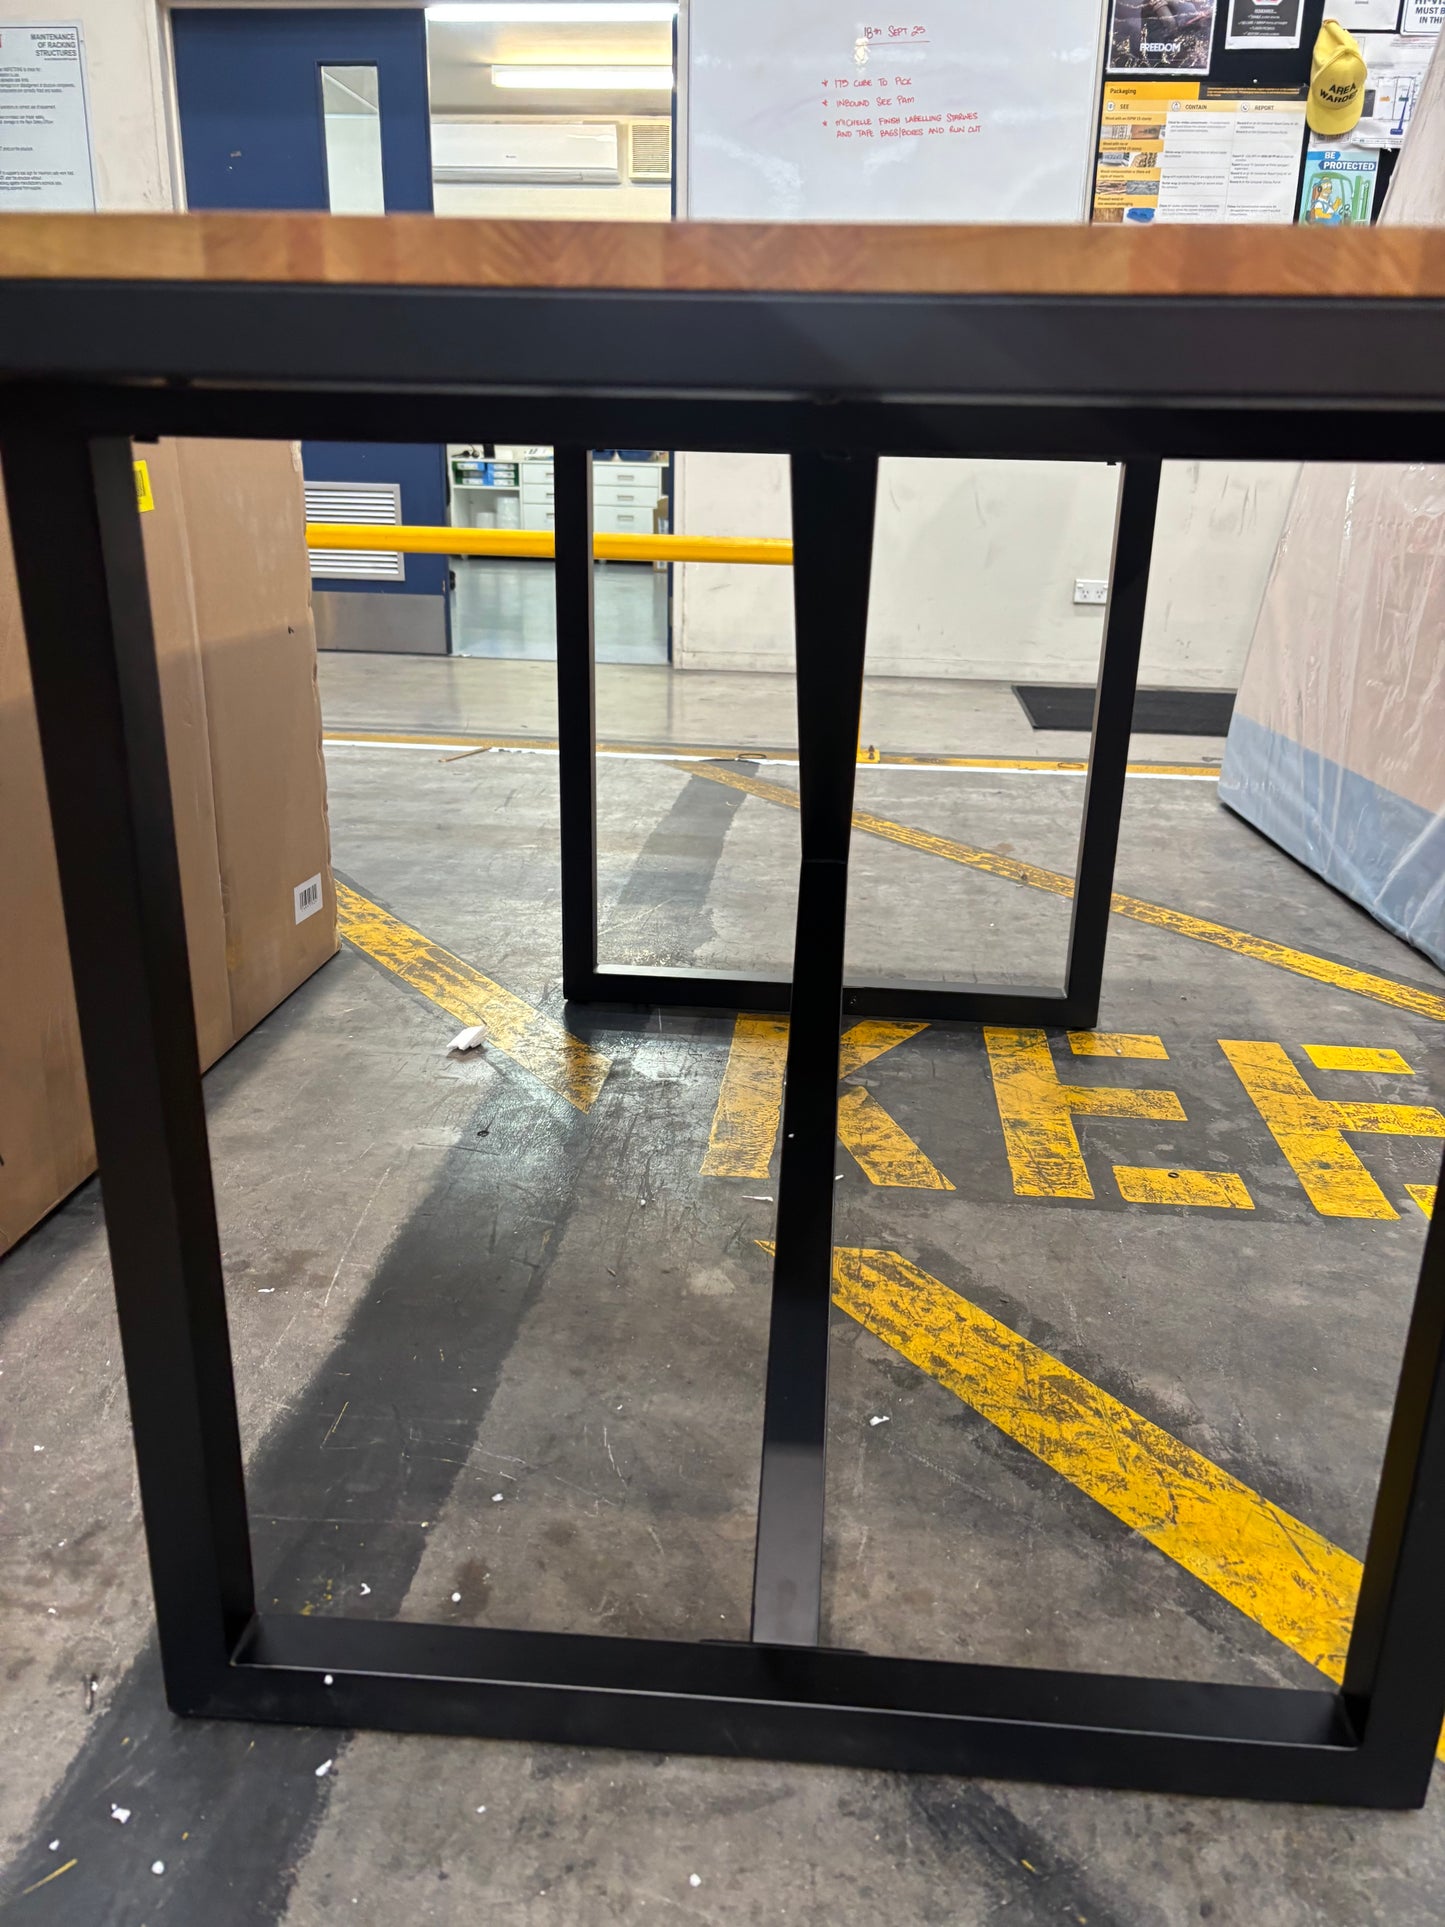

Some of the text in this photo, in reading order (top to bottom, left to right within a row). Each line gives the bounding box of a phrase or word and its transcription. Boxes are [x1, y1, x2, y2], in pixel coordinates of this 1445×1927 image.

[1415, 7, 1439, 15] MUST
[1419, 16, 1445, 24] IN THI
[30, 33, 76, 41] MAINTENANCE
[37, 41, 76, 49] OF RACKING
[1139, 42, 1181, 52] FREEDOM
[35, 49, 77, 57] STRUCTURES
[877, 77, 888, 87] TO
[895, 76, 912, 86] PICK
[1329, 82, 1356, 95] AREA
[836, 98, 870, 108] INBOUND
[876, 96, 892, 106] SEE
[905, 114, 942, 124] LABELLING
[837, 130, 853, 138] AND
[857, 128, 875, 138] TAPE
[928, 127, 945, 135] AND
[949, 125, 965, 133] RUN
[1324, 151, 1336, 159] BE
[1323, 161, 1375, 170] PROTECTED
